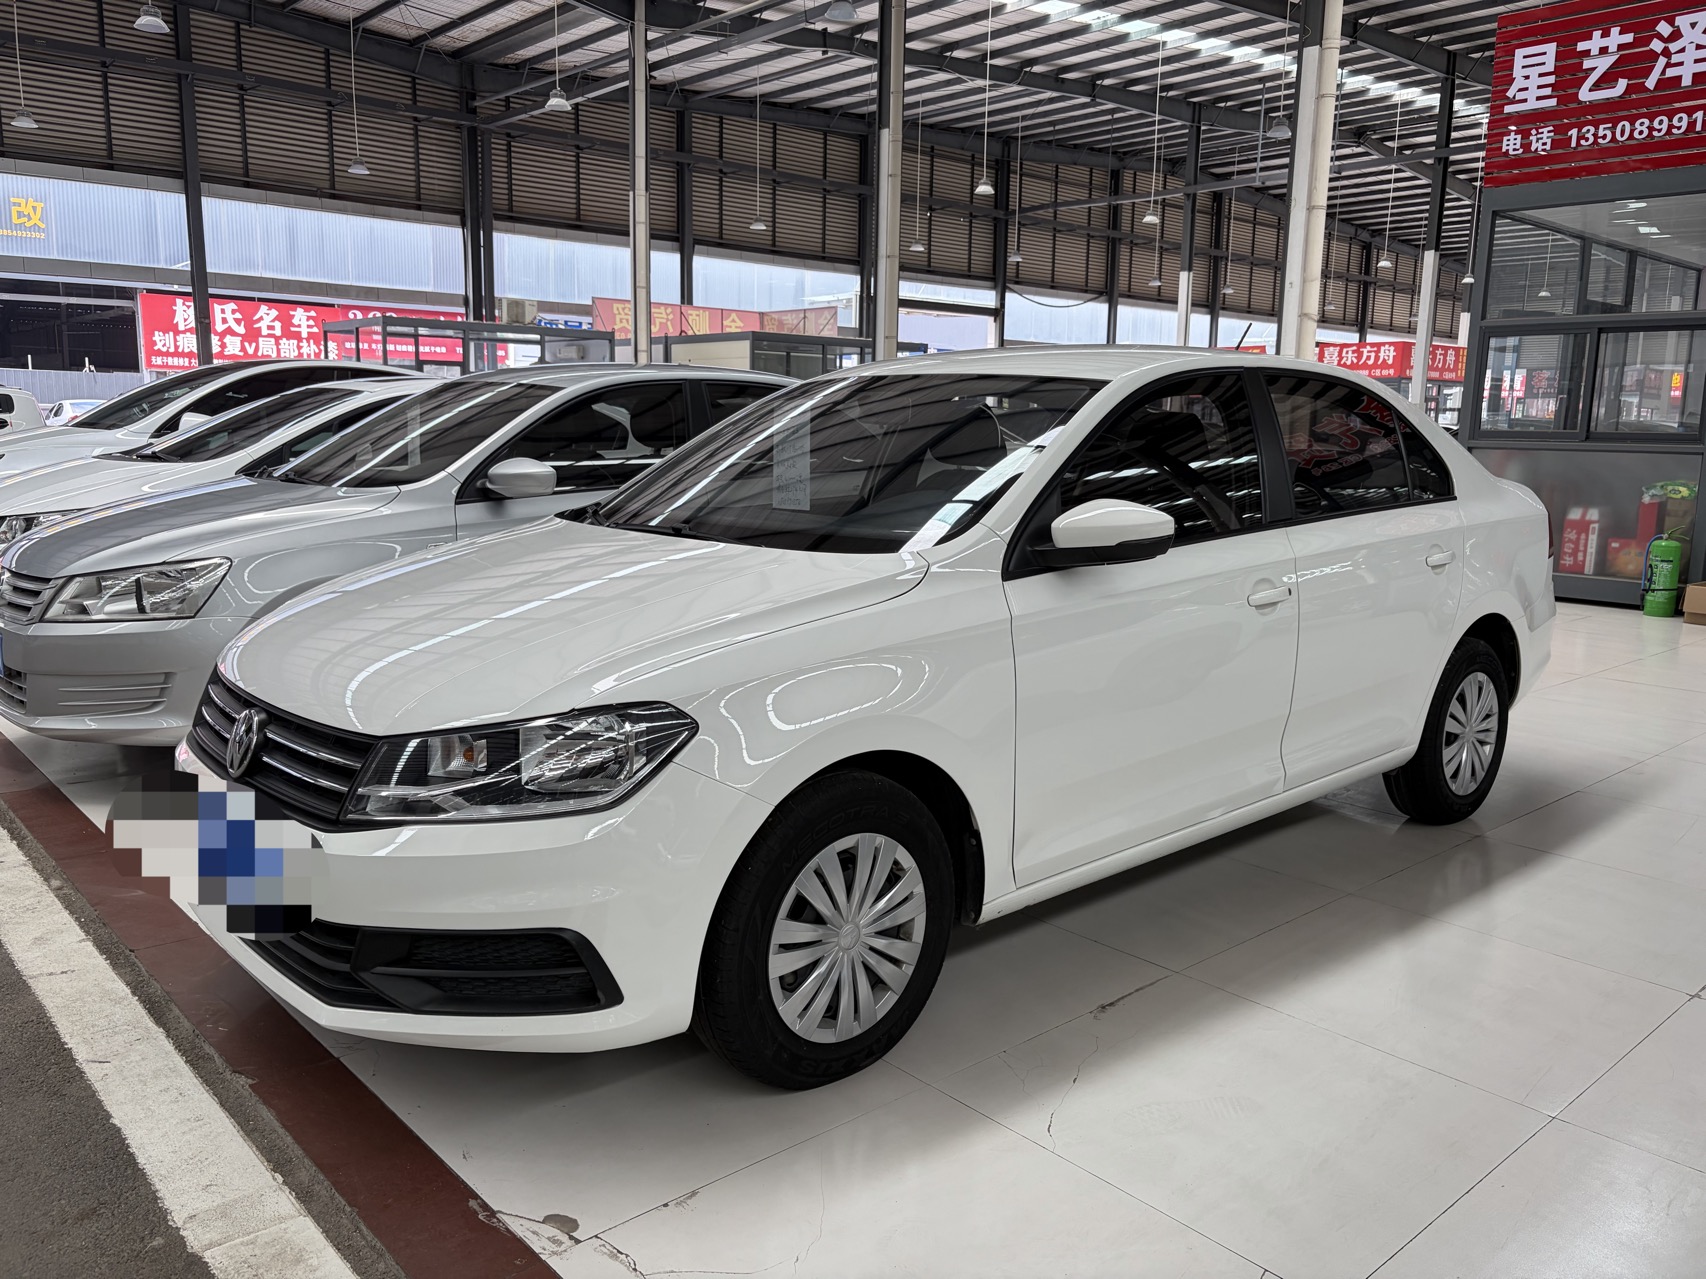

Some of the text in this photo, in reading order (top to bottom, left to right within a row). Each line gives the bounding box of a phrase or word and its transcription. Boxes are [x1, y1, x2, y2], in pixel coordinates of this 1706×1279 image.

[1502, 110, 1705, 156] 电话 13508991
[10, 197, 46, 229] 改
[1323, 344, 1396, 366] 喜乐方舟
